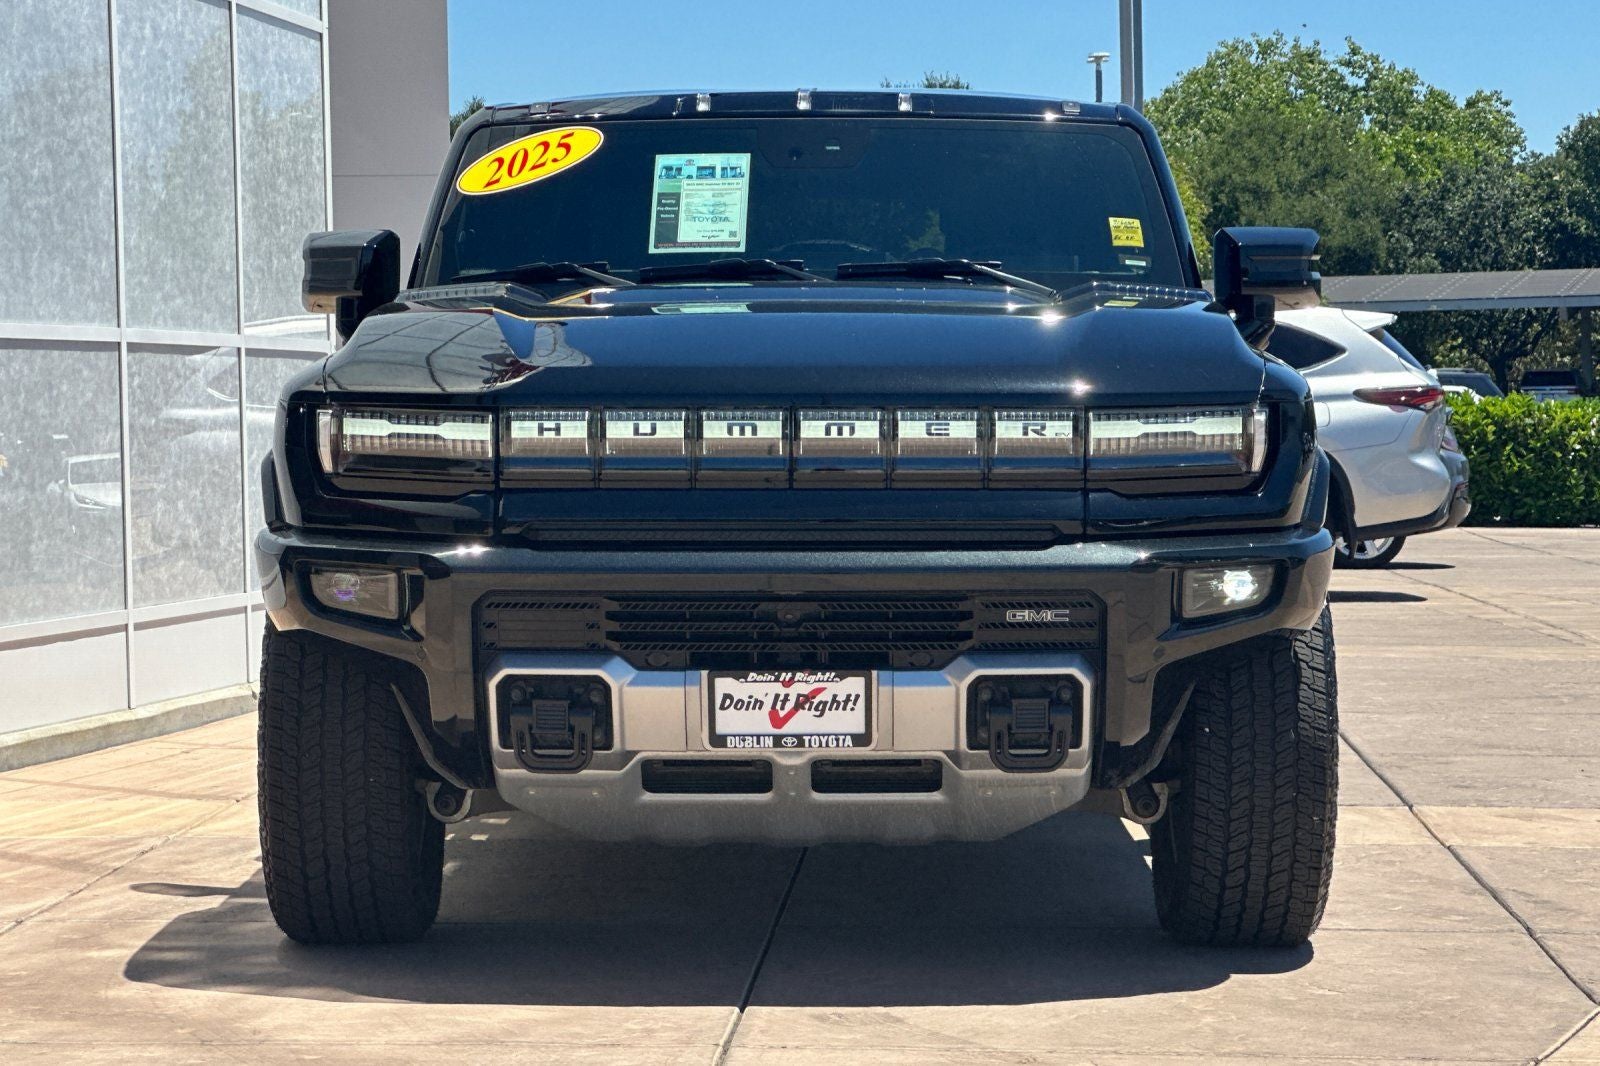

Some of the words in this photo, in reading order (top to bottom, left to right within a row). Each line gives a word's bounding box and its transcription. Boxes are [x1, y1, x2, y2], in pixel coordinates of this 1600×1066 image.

[483, 132, 575, 188] 2025
[692, 215, 731, 223] TOYOTA
[537, 422, 1047, 437] HUMMER
[1006, 609, 1070, 622] GMC
[747, 672, 778, 682] Doin'
[779, 672, 791, 682] It
[794, 672, 836, 684] Right!
[718, 692, 769, 711] Doin'
[770, 692, 791, 711] It
[793, 692, 861, 718] Right!
[726, 735, 774, 748] DUBLIN
[803, 735, 853, 747] TOYOTA
